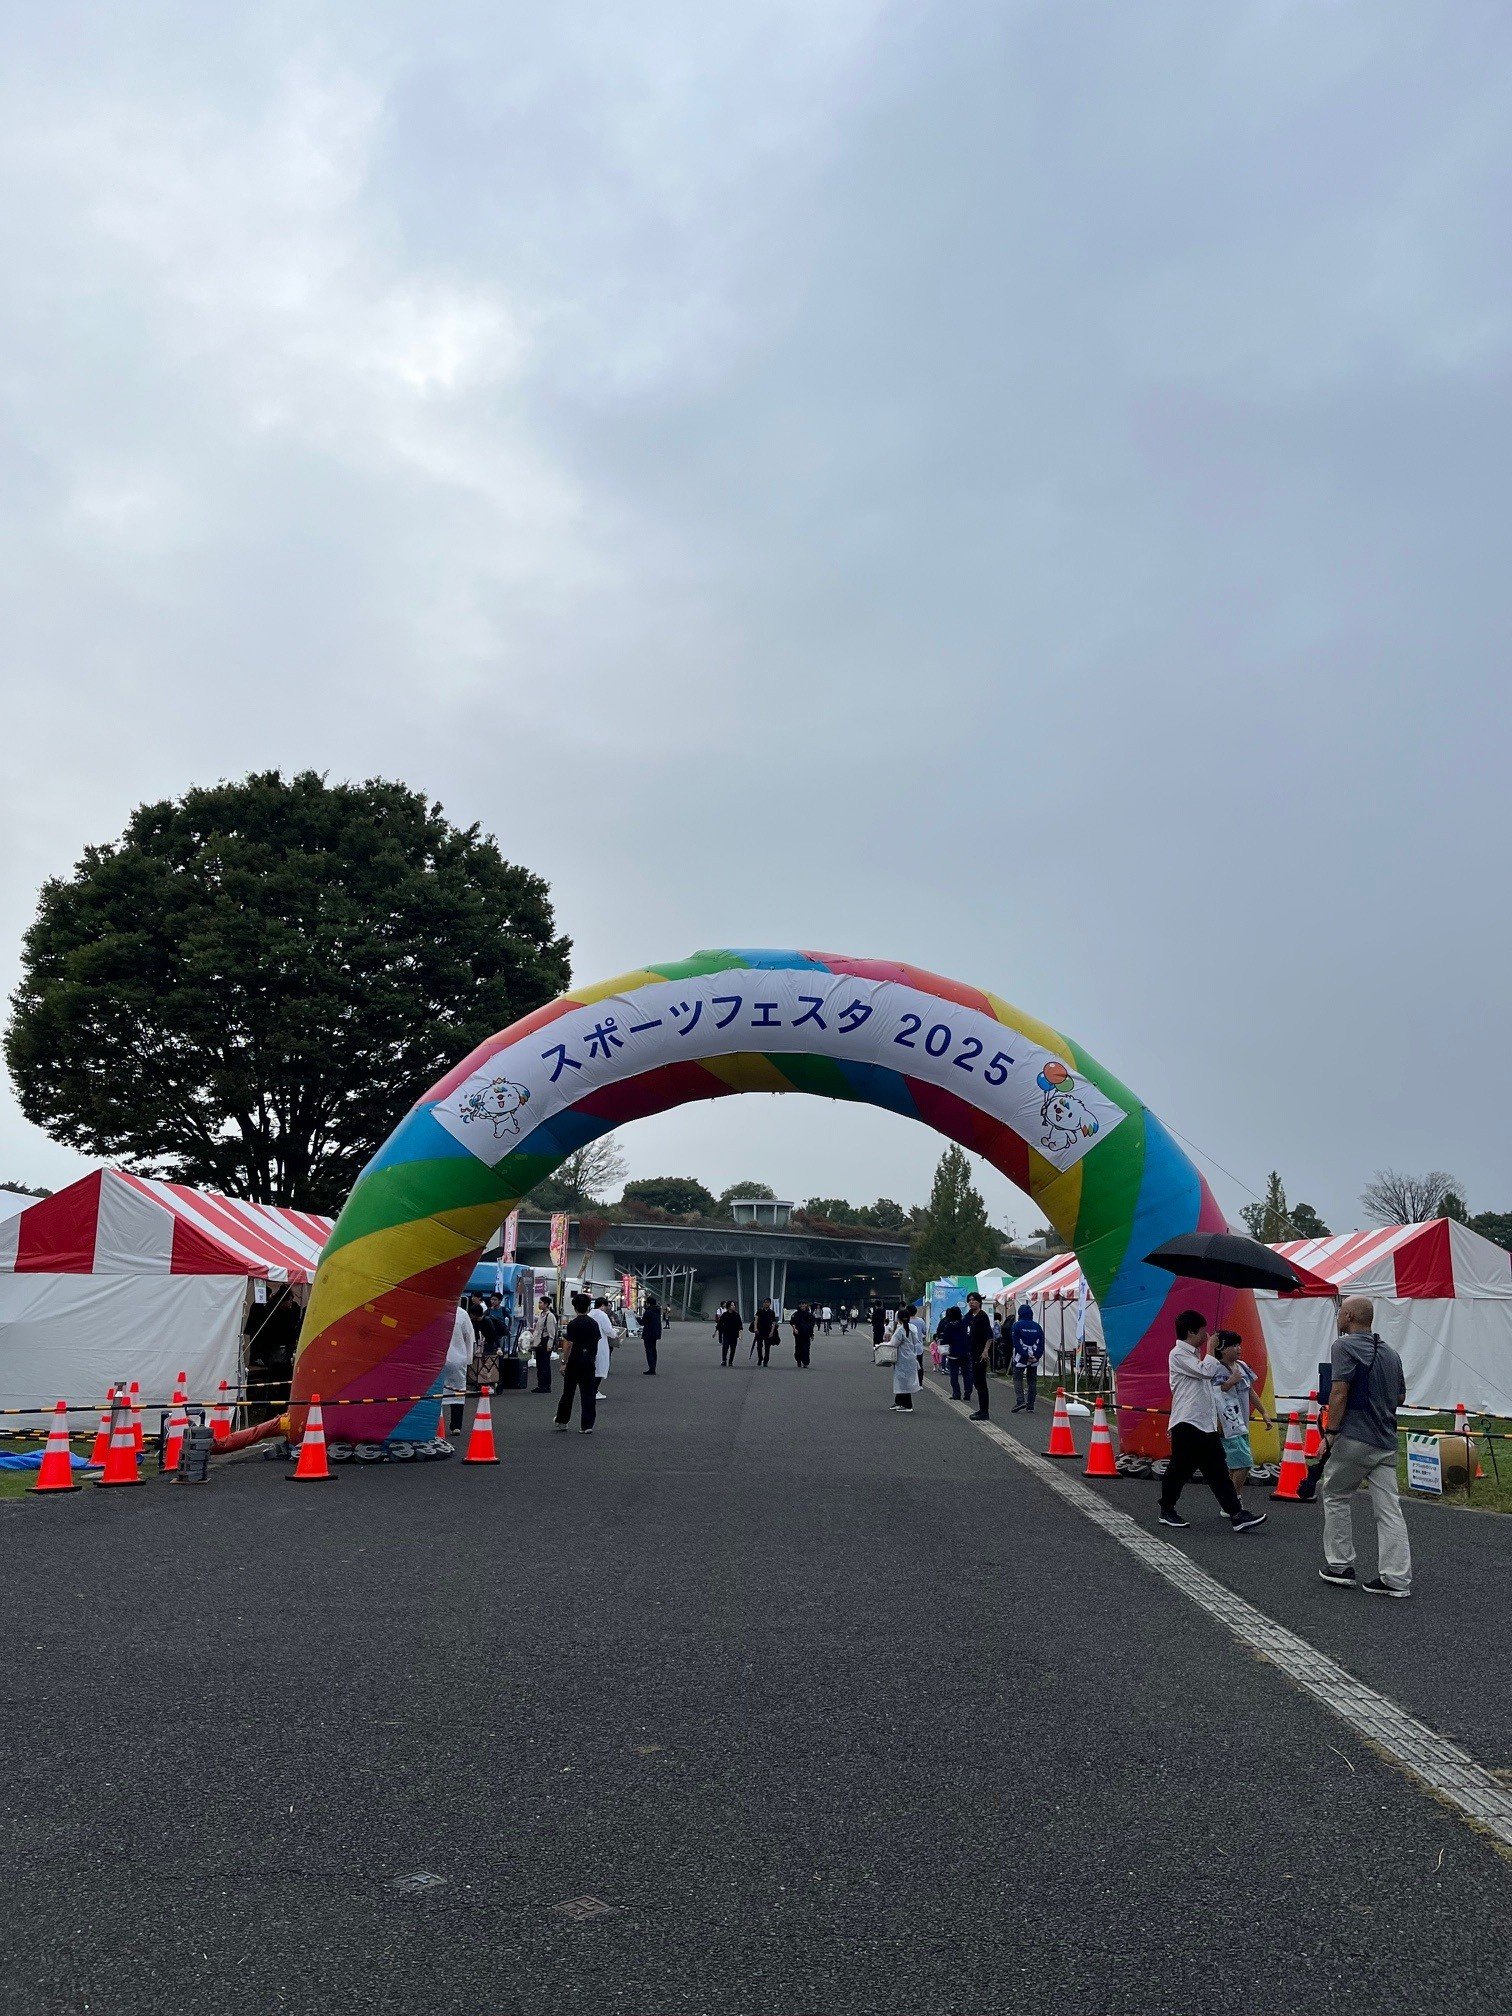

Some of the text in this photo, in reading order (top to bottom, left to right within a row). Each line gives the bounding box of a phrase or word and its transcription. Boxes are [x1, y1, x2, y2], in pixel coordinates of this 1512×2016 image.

[540, 994, 1016, 1086] スポーツフェスタ 2025
